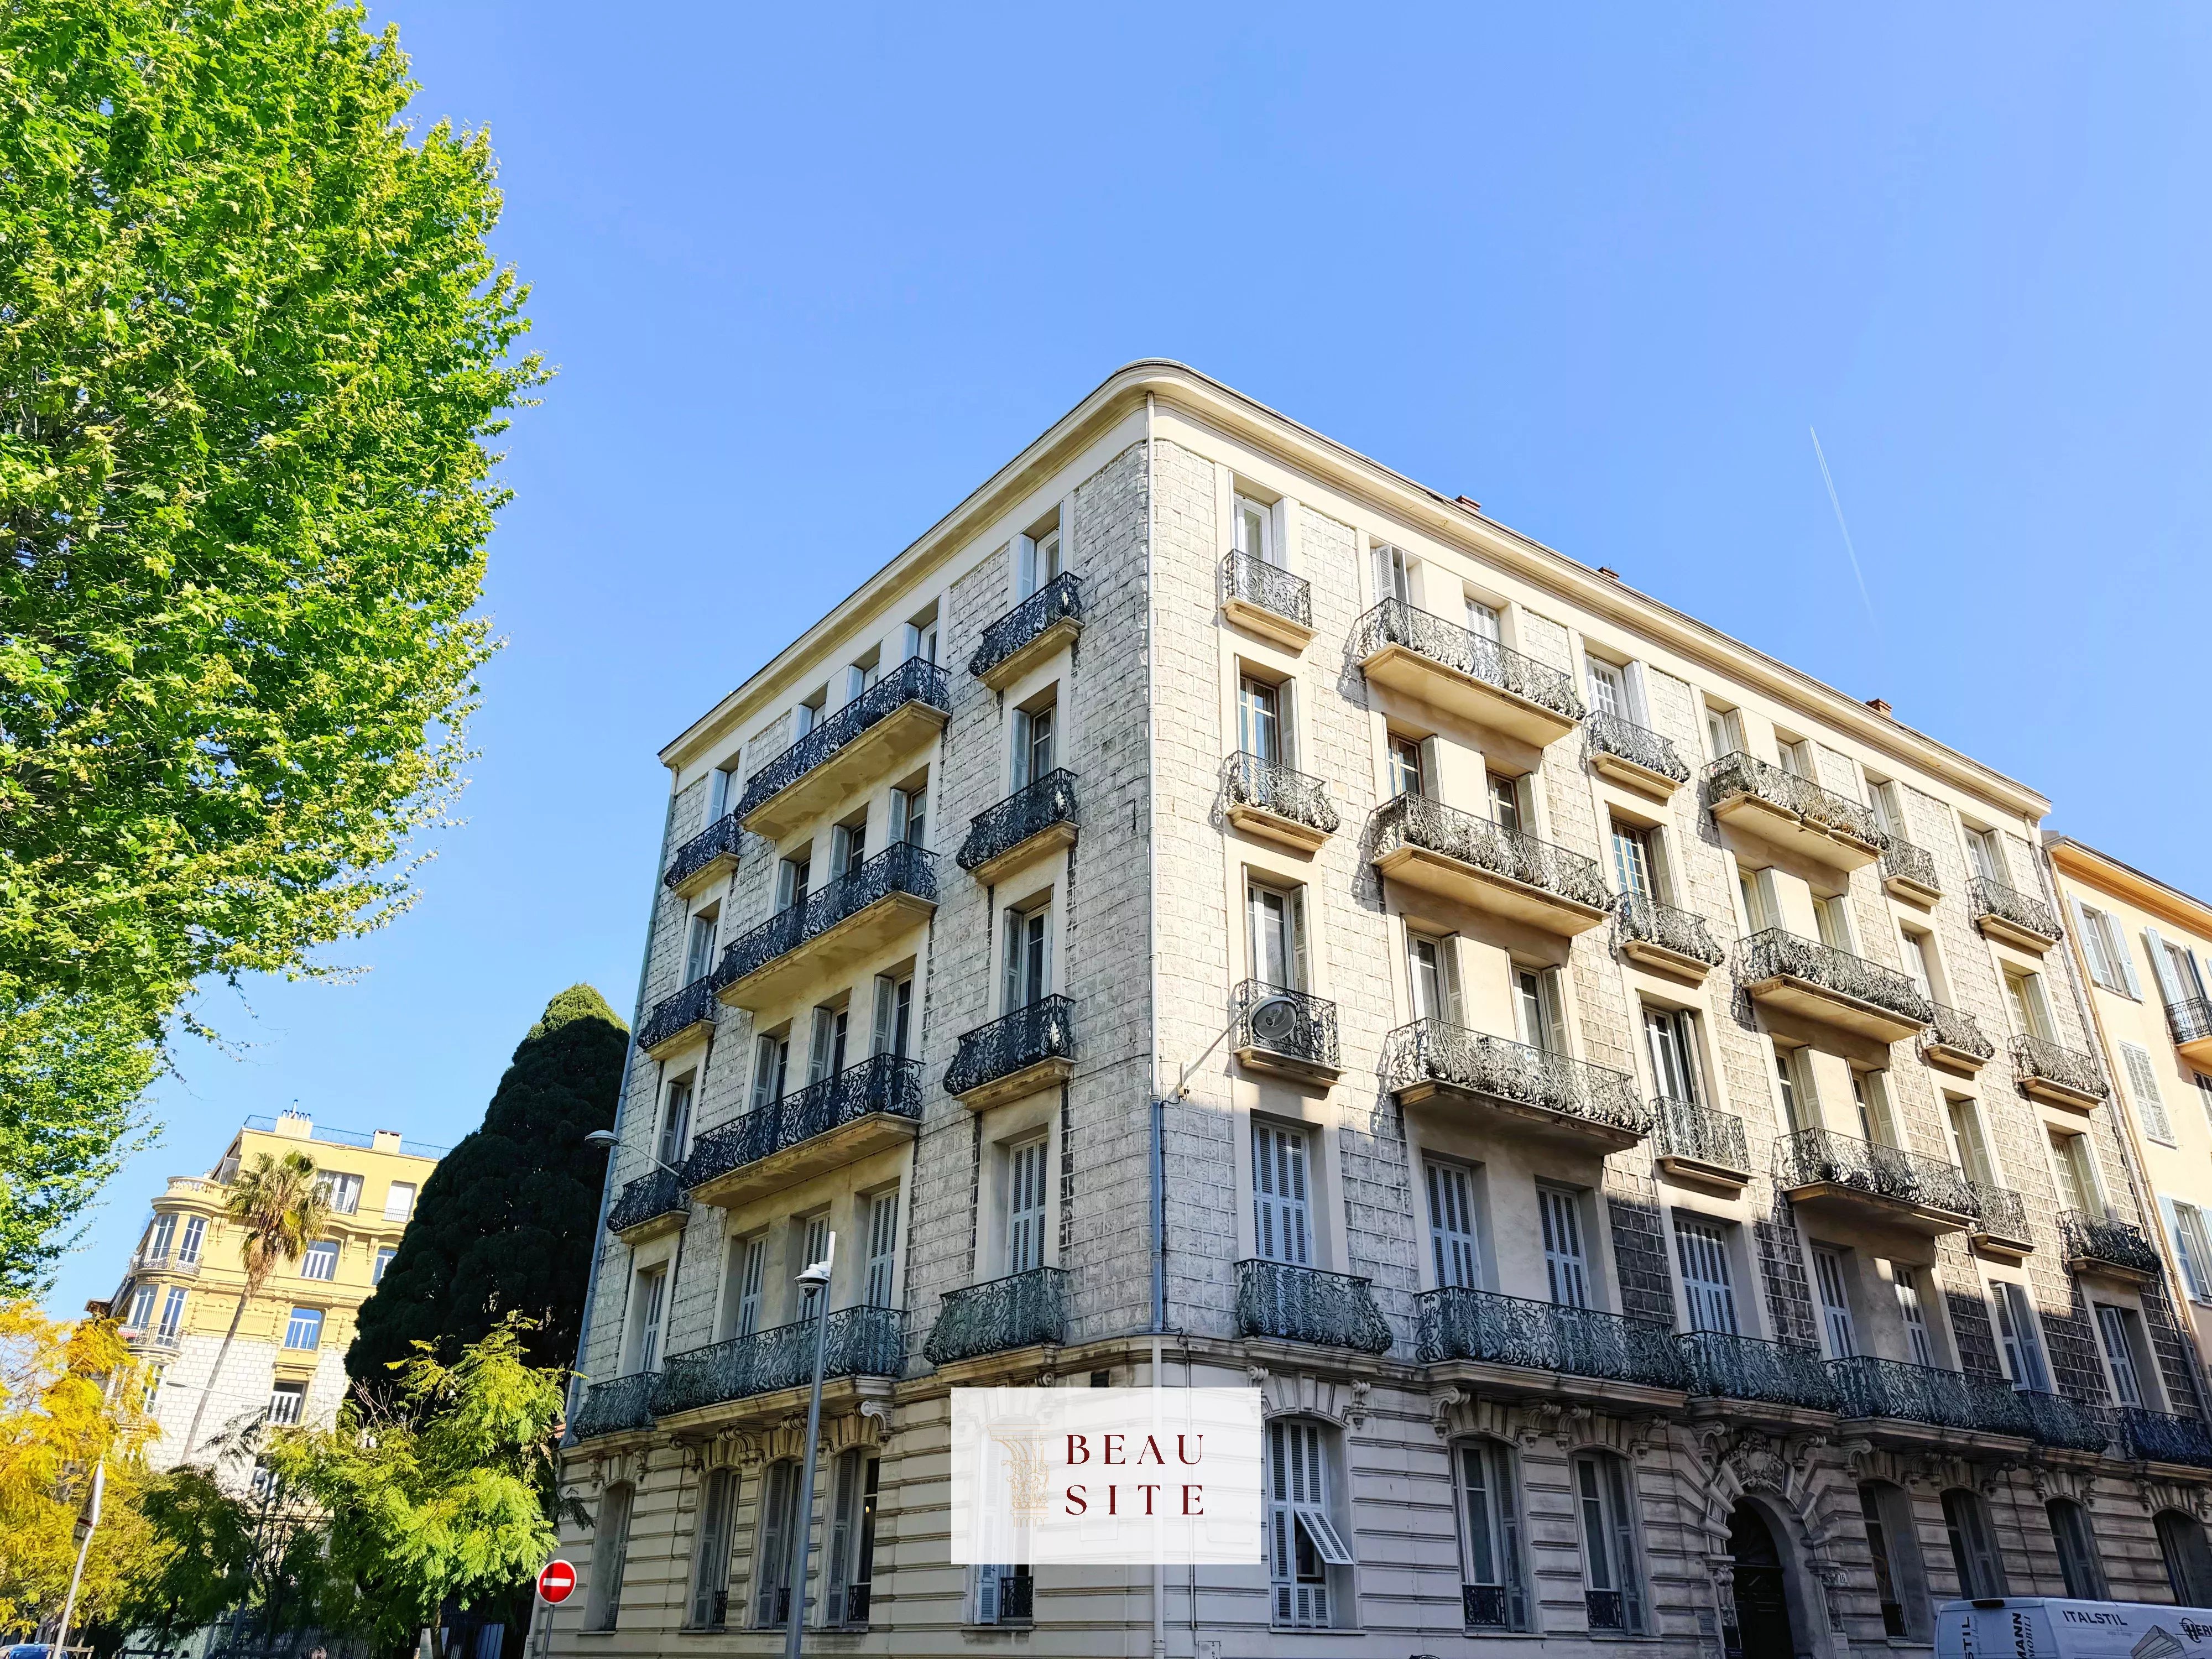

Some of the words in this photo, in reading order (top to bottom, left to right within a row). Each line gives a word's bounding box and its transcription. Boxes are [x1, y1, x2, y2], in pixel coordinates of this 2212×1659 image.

[2062, 1610, 2128, 1625] ITALSTIL
[2024, 1616, 2035, 1658] MOBILI
[2182, 1621, 2212, 1641] HER
